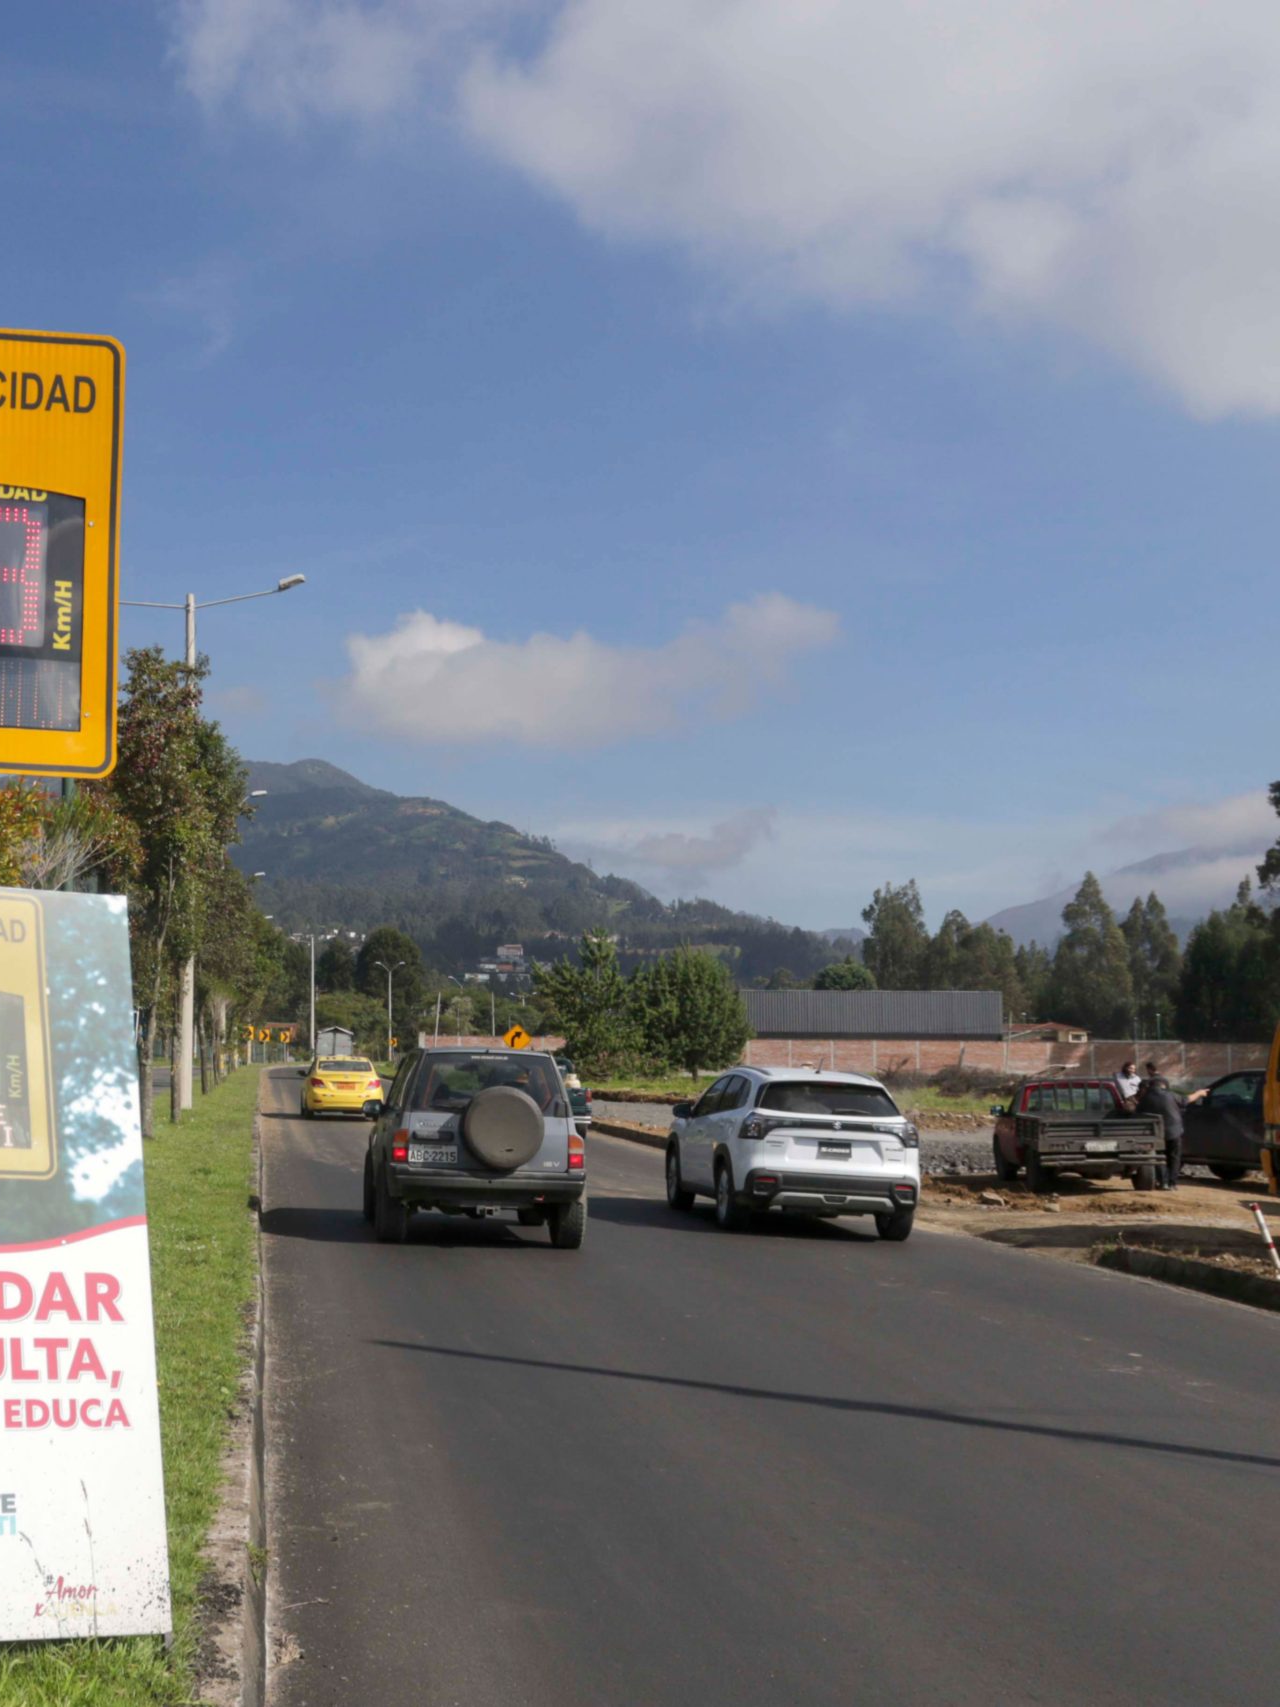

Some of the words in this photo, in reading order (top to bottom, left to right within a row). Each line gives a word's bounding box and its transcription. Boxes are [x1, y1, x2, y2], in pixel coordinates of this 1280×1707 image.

[52, 580, 72, 651] Km/H
[6, 1055, 22, 1098] Km/H
[409, 1150, 457, 1162] ABC-2215
[3, 1398, 132, 1428] EDUCA
